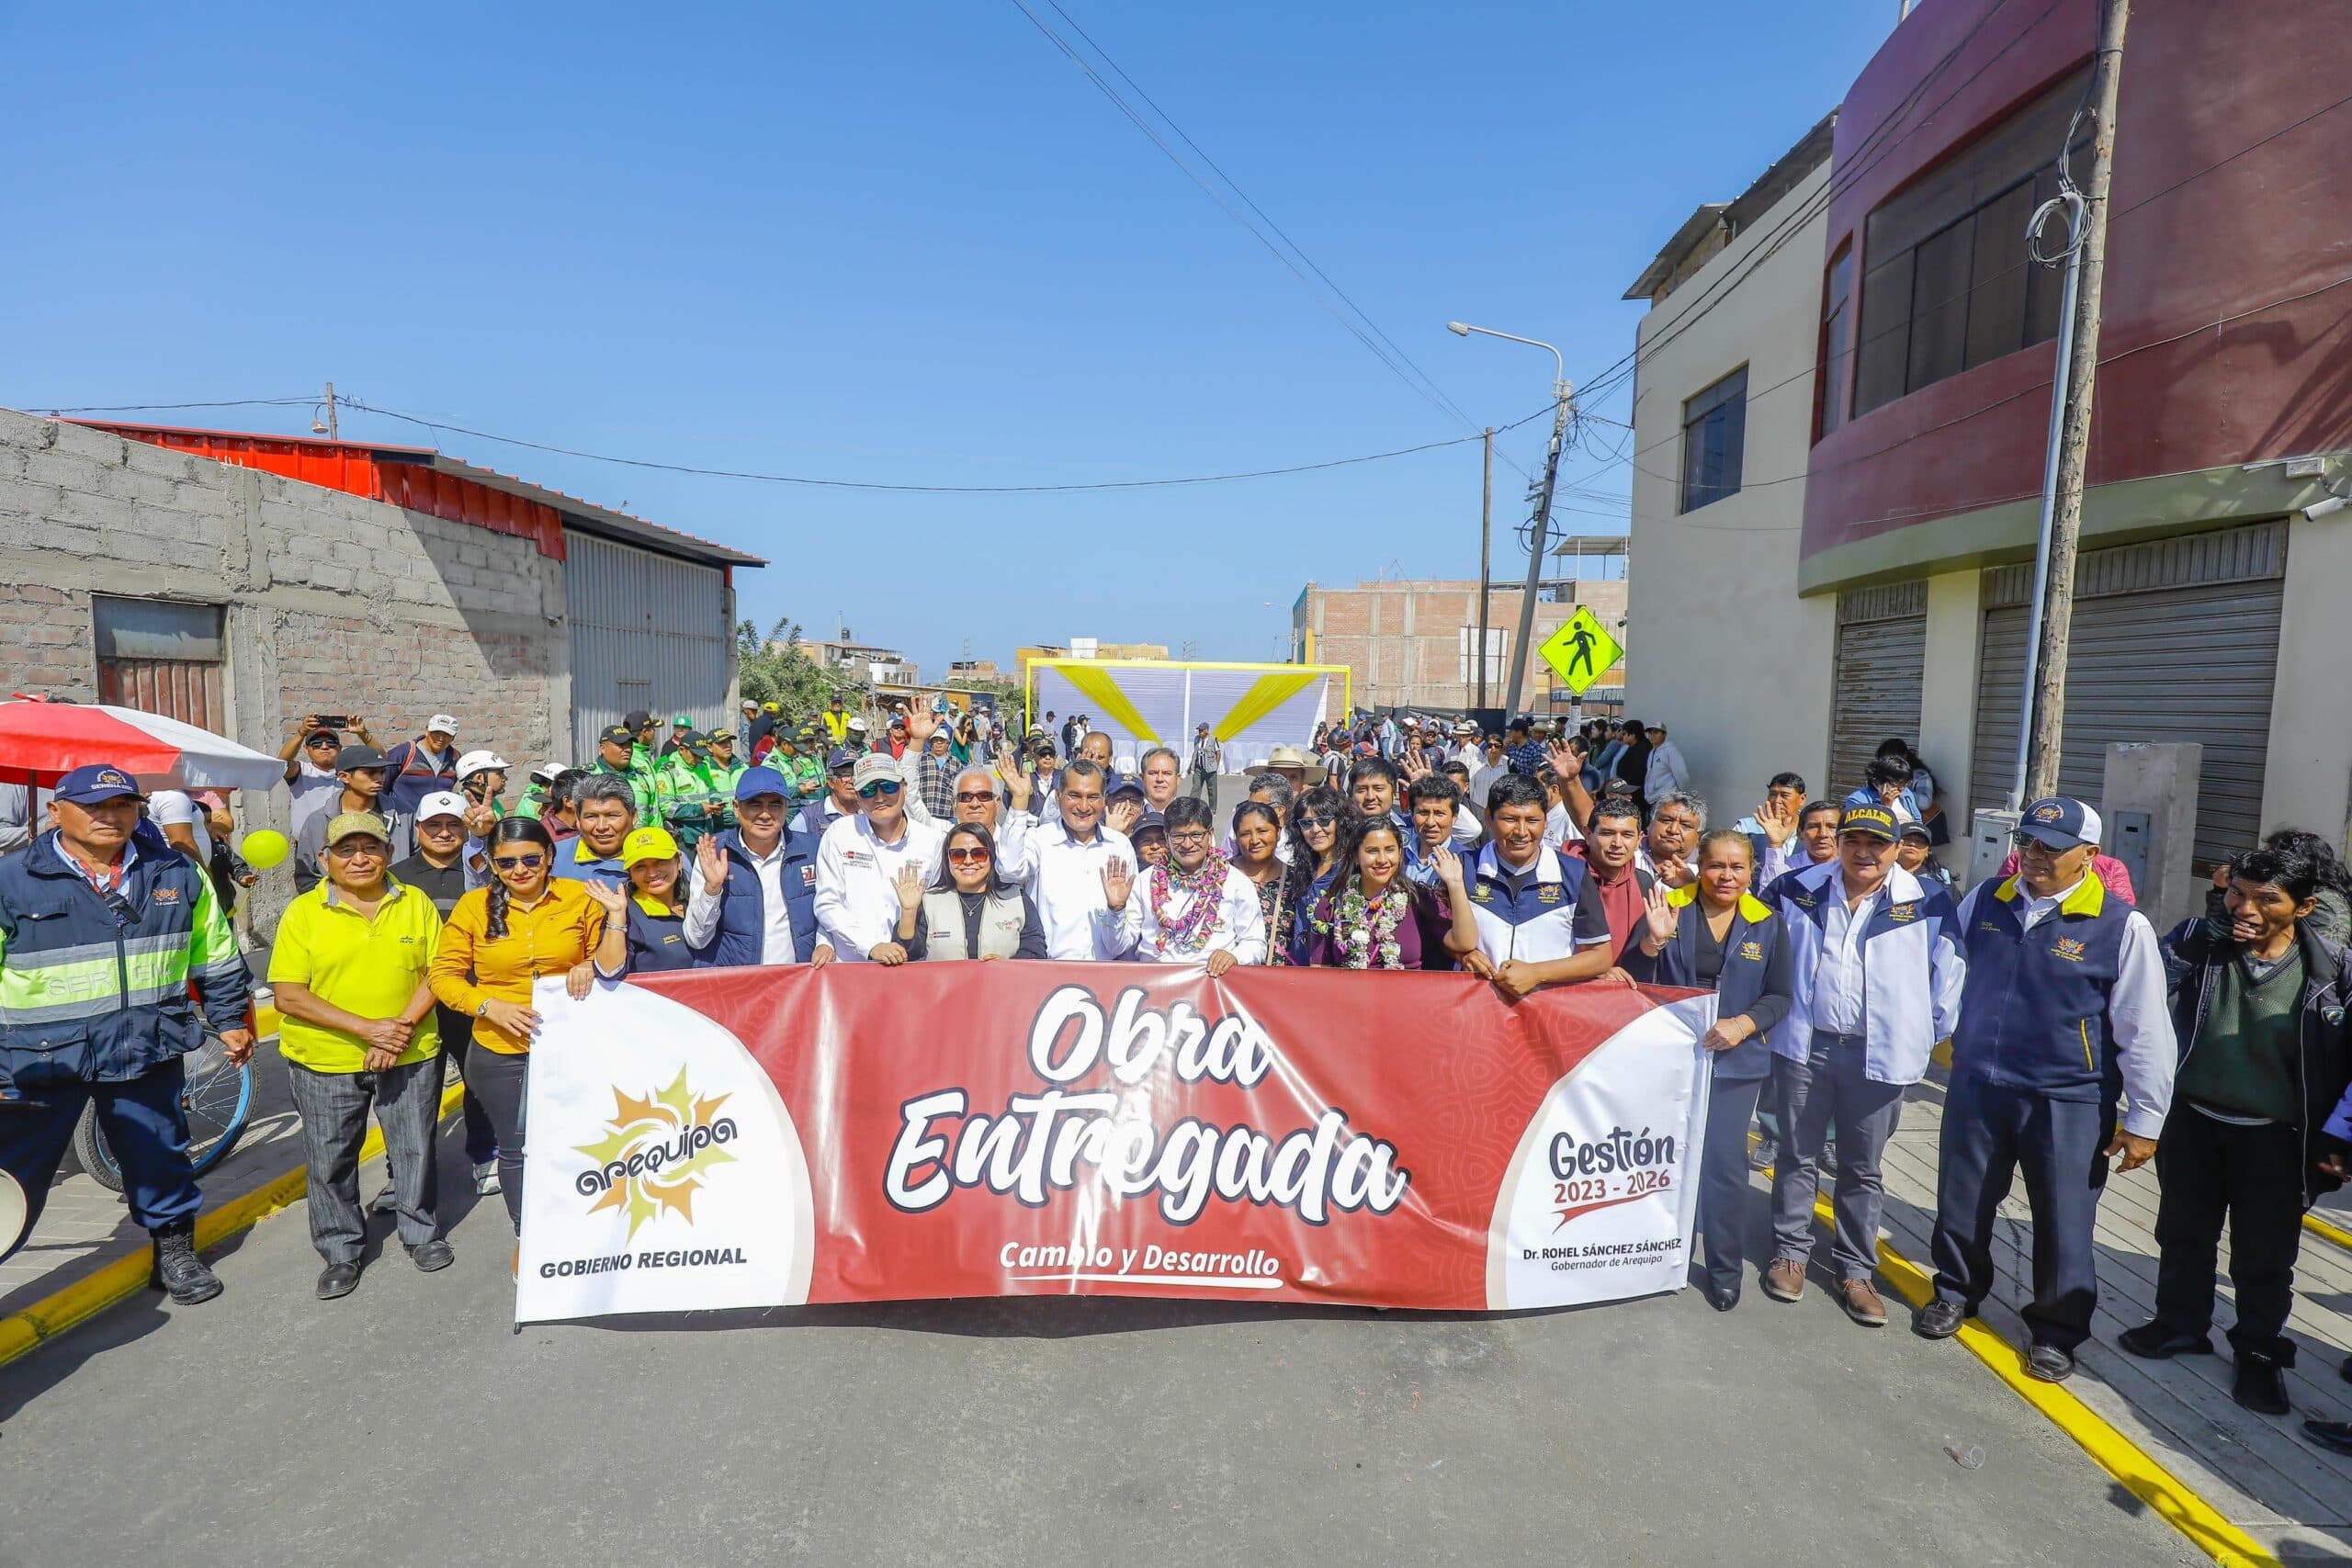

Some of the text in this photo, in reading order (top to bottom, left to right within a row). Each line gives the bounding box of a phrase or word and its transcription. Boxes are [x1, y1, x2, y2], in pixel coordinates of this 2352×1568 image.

[1844, 808, 1893, 829] ALCALDE
[1027, 981, 1272, 1089] Obra
[883, 1087, 1410, 1227] Entregada
[1549, 1126, 1676, 1180] Gestión
[1554, 1179, 1607, 1204] 2023
[1626, 1168, 1670, 1195] 2026
[539, 1247, 748, 1279] GOBIERNO REGIONAL
[1117, 1247, 1138, 1275] y
[1142, 1244, 1280, 1276] Desarrollo
[1523, 1237, 1682, 1260] Dr. ROHEL SÁNCHEZ SÁNCHEZ
[1551, 1255, 1662, 1271] Gobernador de Arequipa
